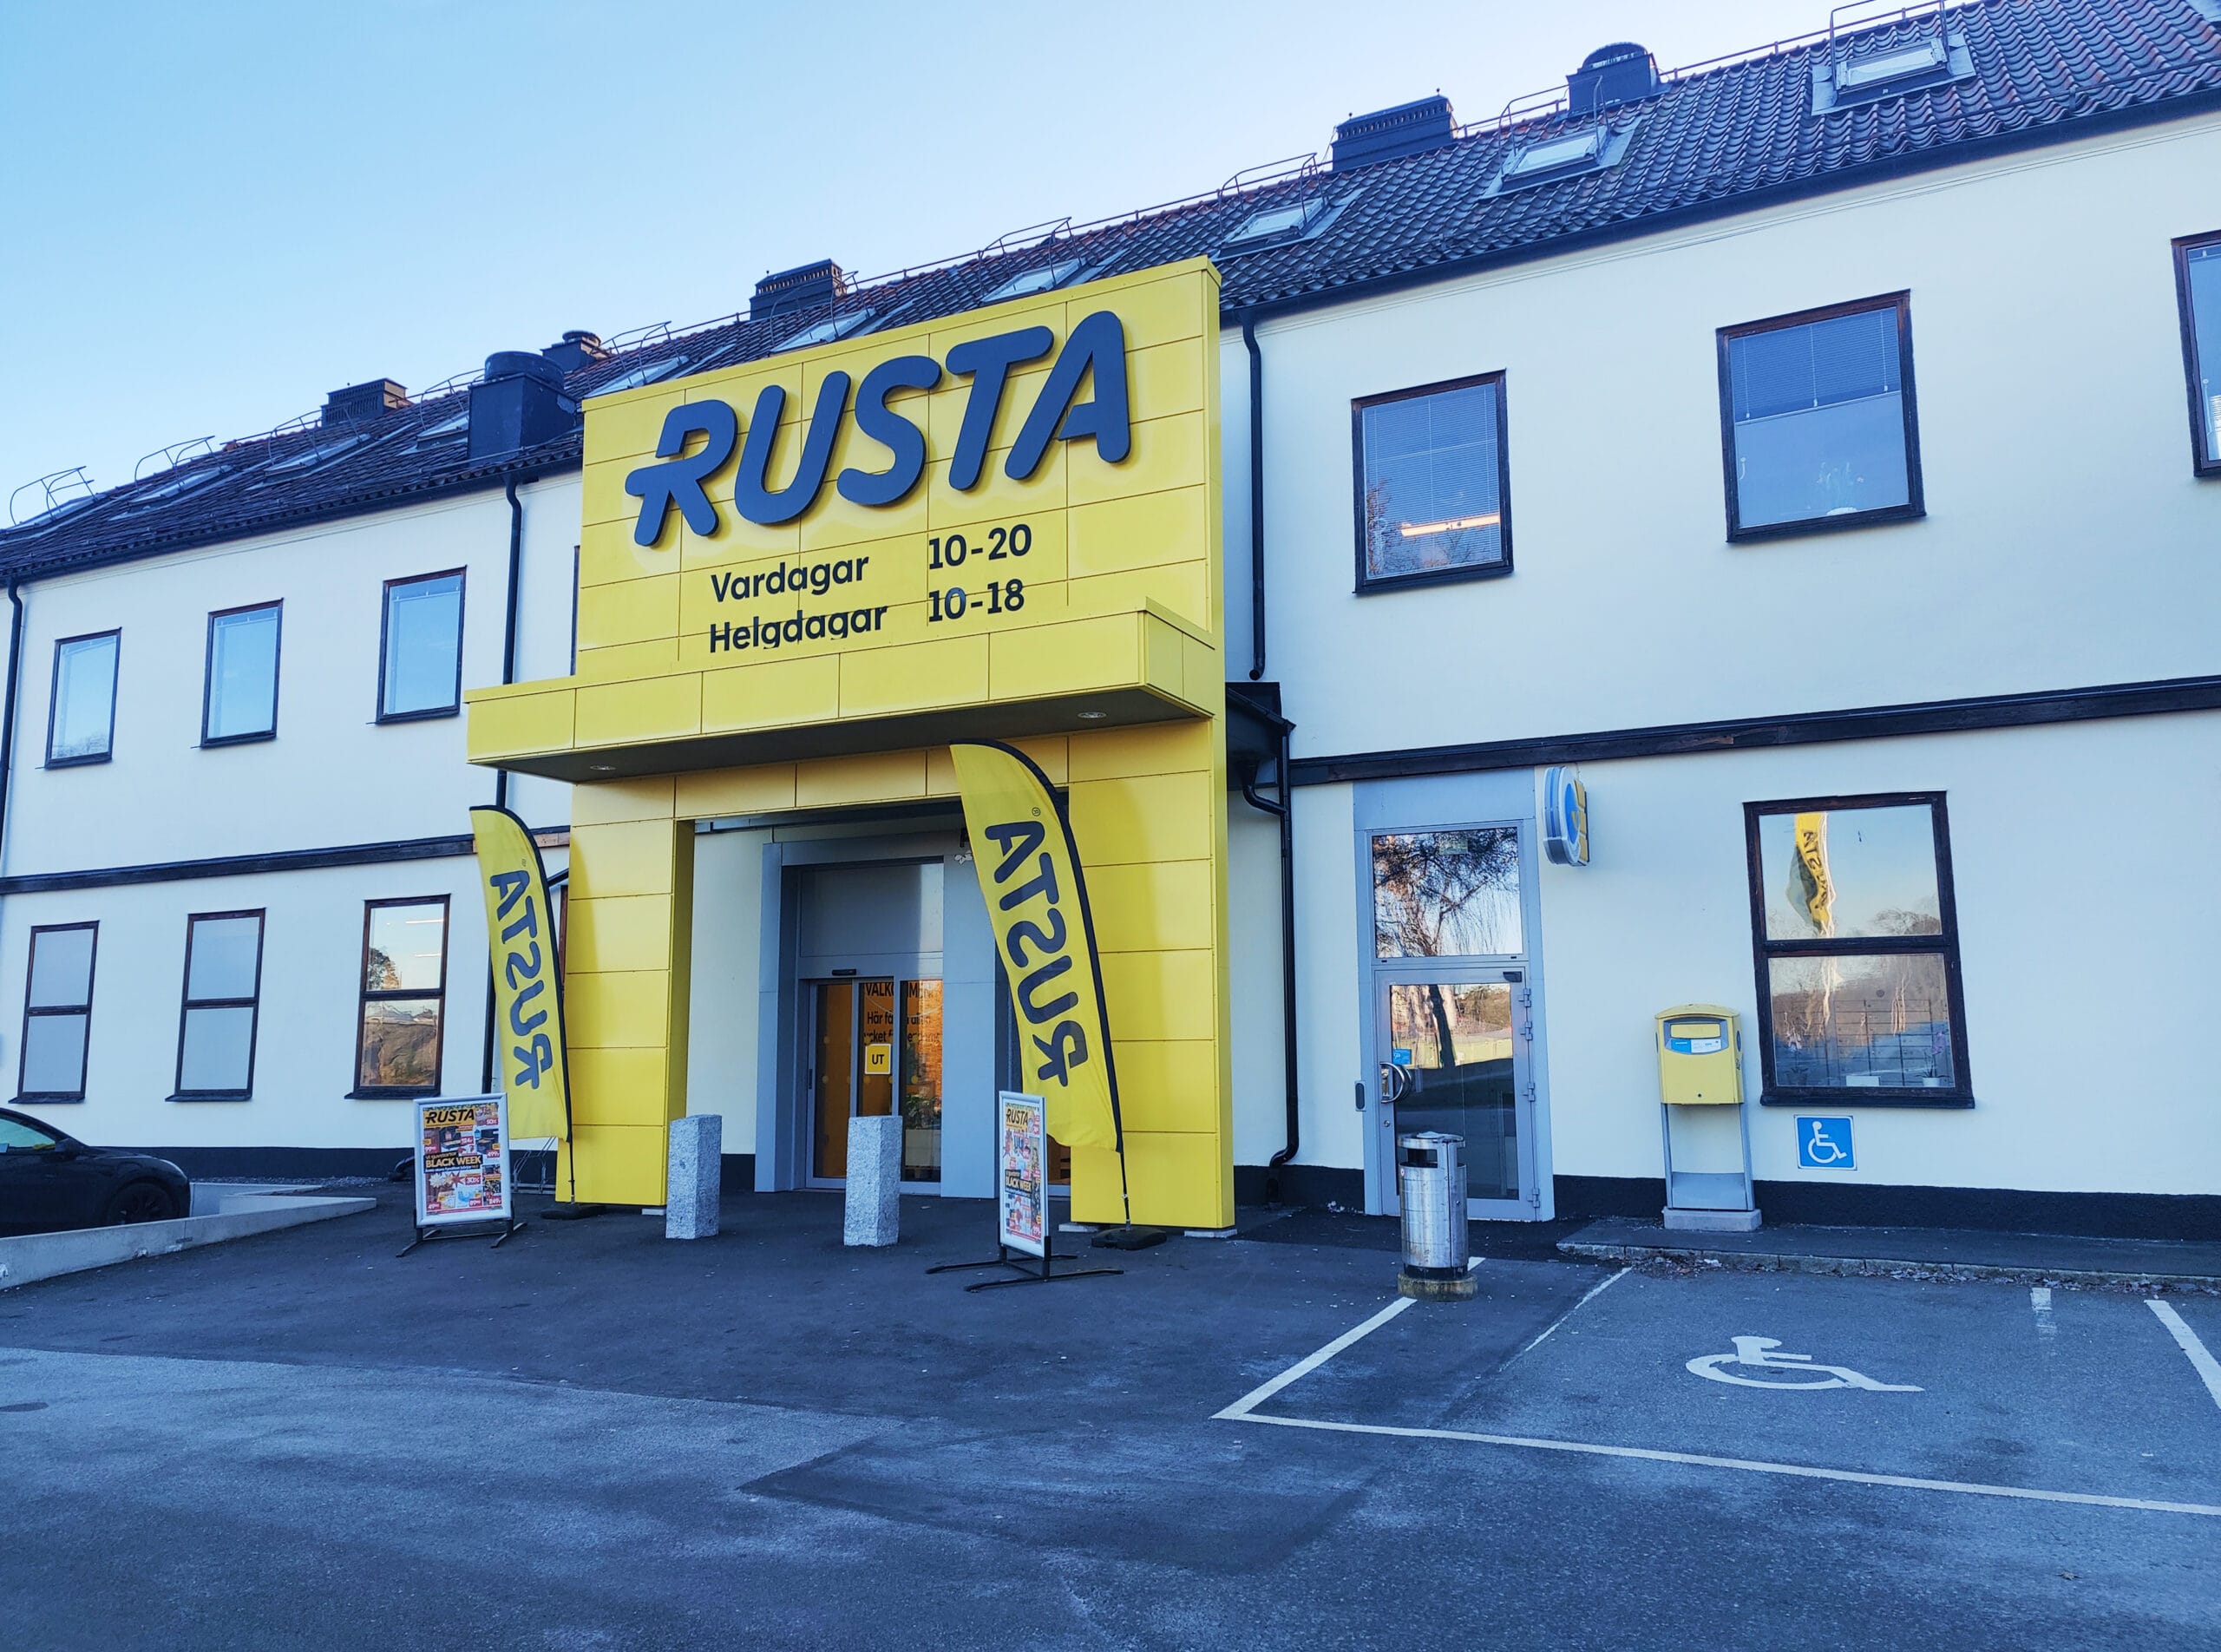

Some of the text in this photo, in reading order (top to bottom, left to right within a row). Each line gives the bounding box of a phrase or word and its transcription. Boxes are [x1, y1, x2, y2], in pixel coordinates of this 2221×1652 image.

[625, 310, 1130, 547] RUSTA
[711, 523, 1032, 603] Vardagar 10-20
[710, 579, 1025, 653] Helgdagar 10-18
[868, 1011, 883, 1024] Här
[872, 1053, 885, 1065] UT
[425, 1109, 475, 1124] RUSTA
[1006, 1108, 1028, 1125] RUSTA
[426, 1156, 482, 1168] BLACK WEEK
